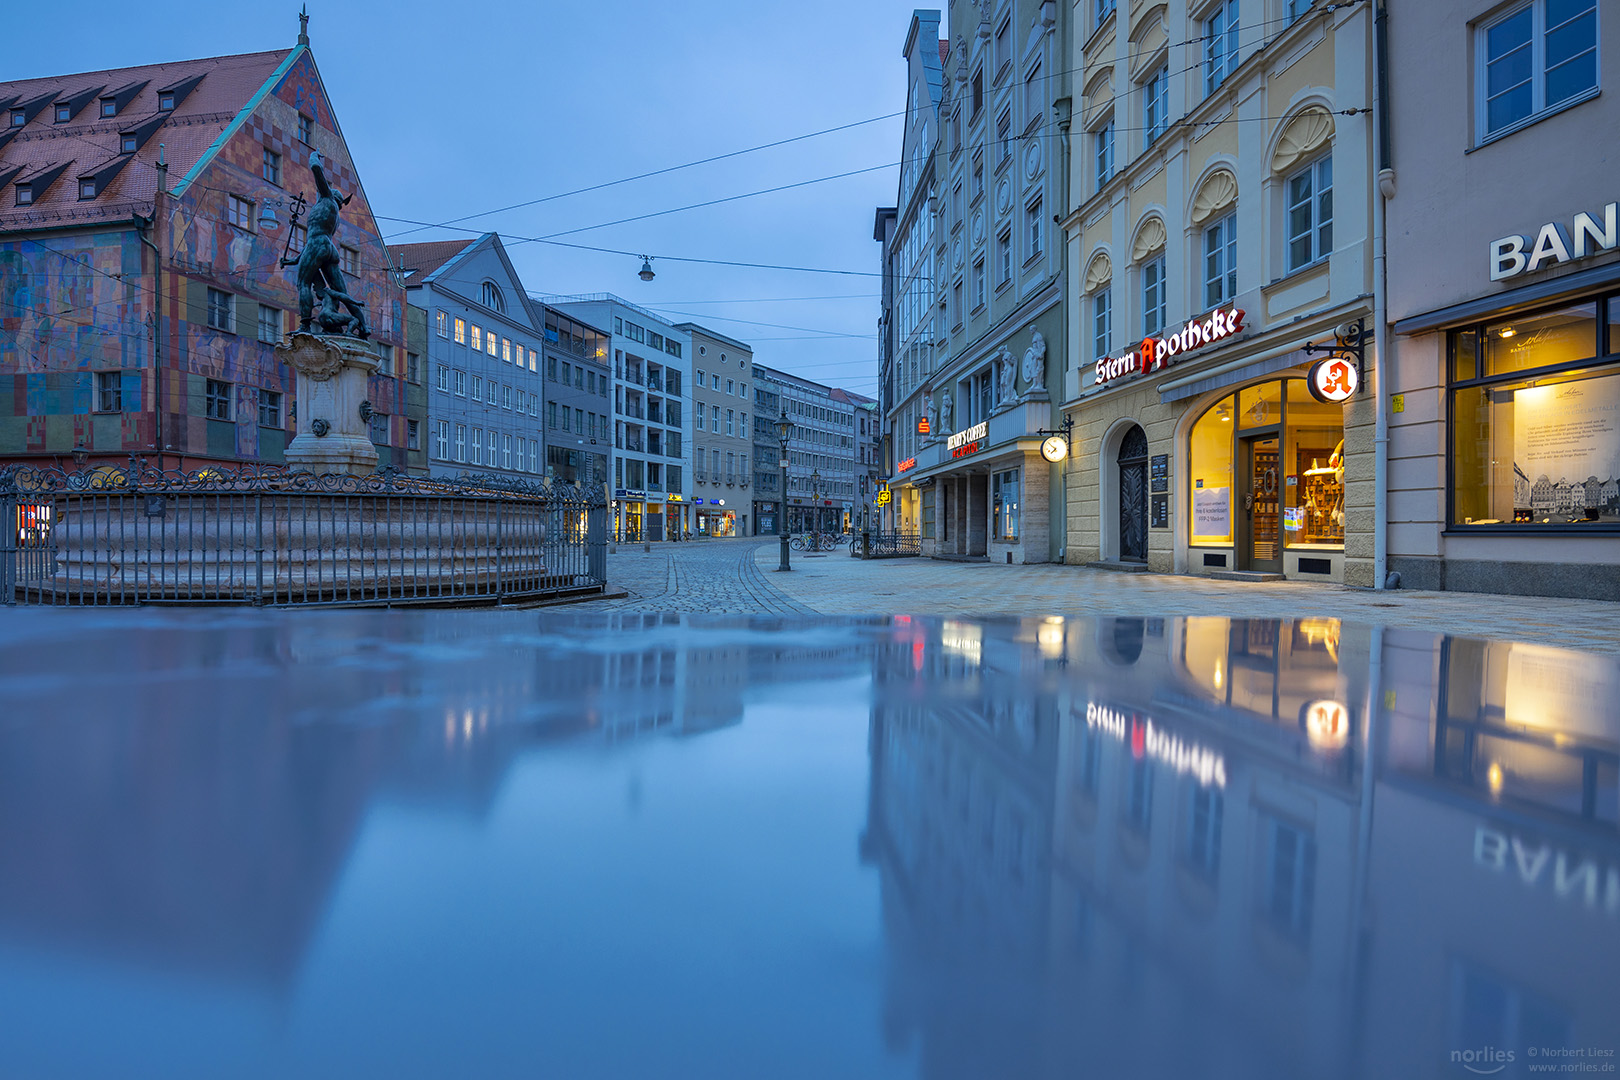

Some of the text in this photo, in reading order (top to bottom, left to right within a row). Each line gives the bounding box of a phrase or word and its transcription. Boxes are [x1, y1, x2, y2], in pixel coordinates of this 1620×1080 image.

[1489, 201, 1618, 283] BAN
[1094, 308, 1241, 385] Stern Apotheke
[956, 442, 978, 458] CAPITOL
[966, 421, 987, 443] COFFEE
